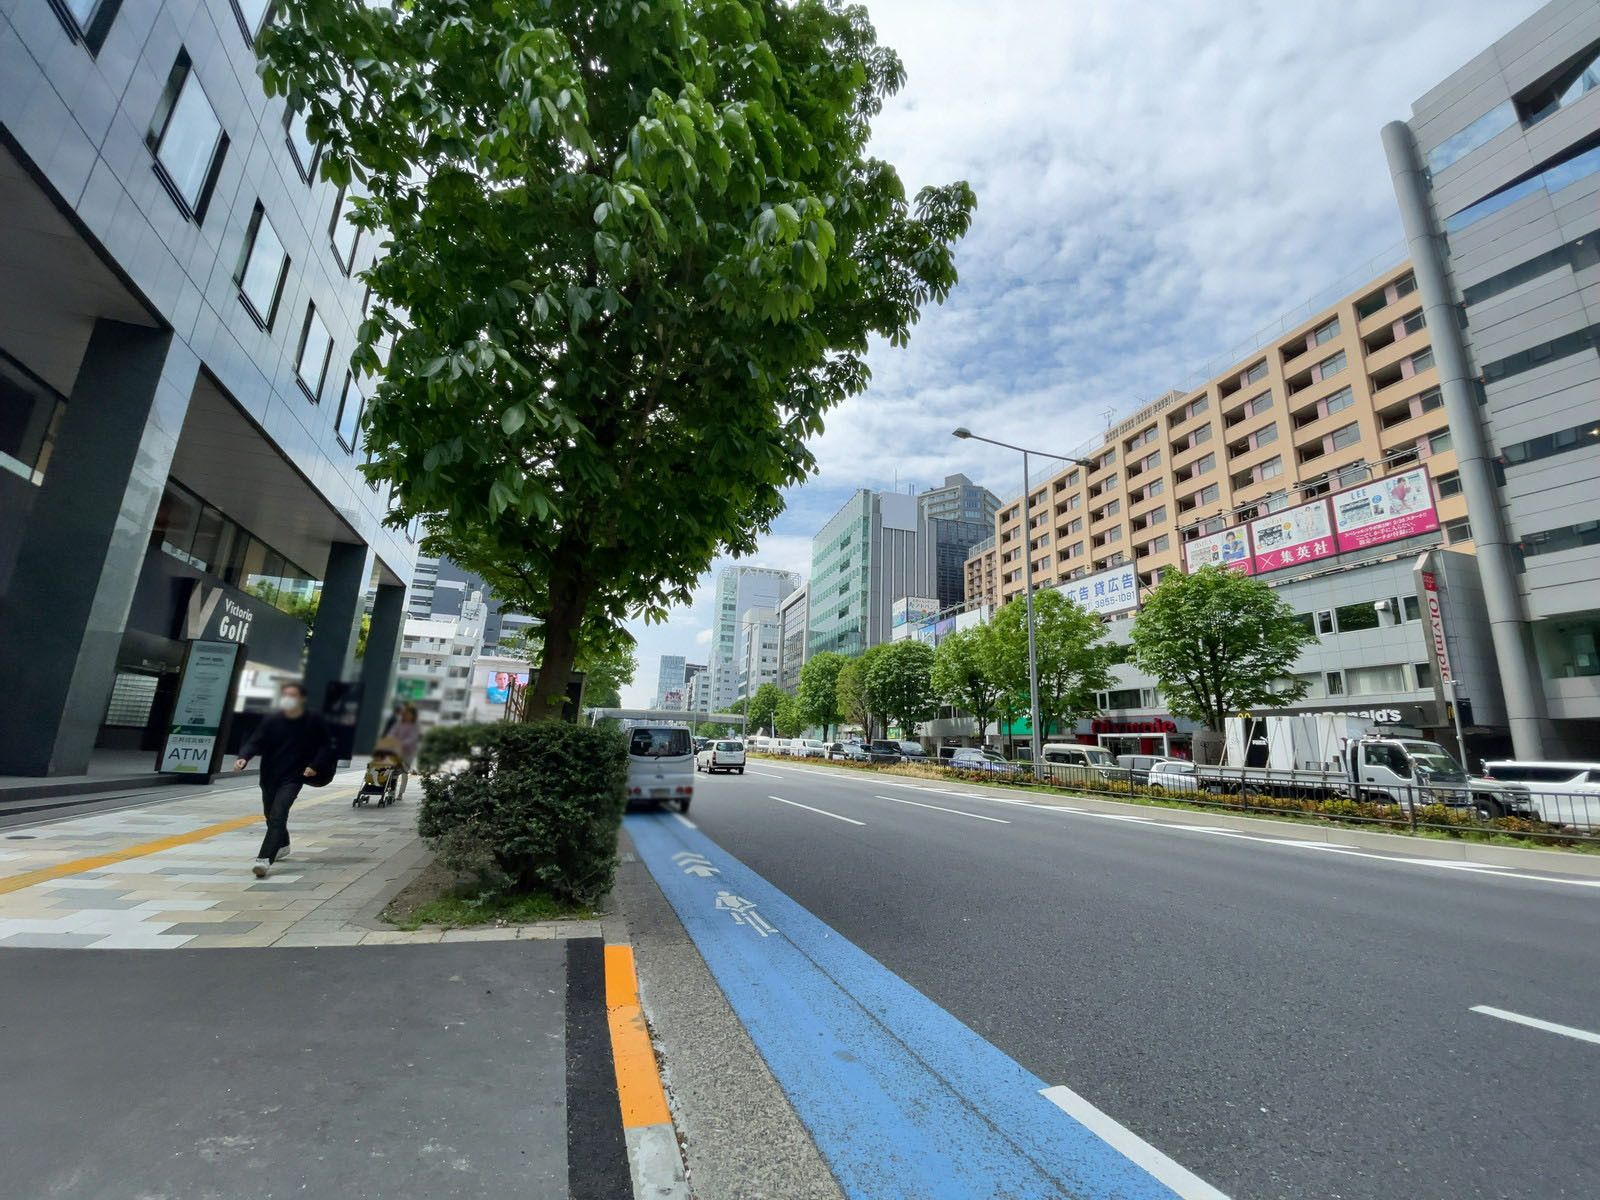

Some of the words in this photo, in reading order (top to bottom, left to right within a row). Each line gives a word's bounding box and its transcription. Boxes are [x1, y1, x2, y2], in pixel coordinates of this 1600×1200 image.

[1350, 488, 1367, 500] LEE
[1280, 540, 1329, 564] 集英社
[1094, 573, 1134, 598] 貸広告
[225, 598, 253, 622] Victoria
[1095, 591, 1136, 609] 3855-1081
[219, 615, 249, 644] Golf
[1428, 598, 1450, 682] Olympic
[168, 748, 208, 761] ATM
